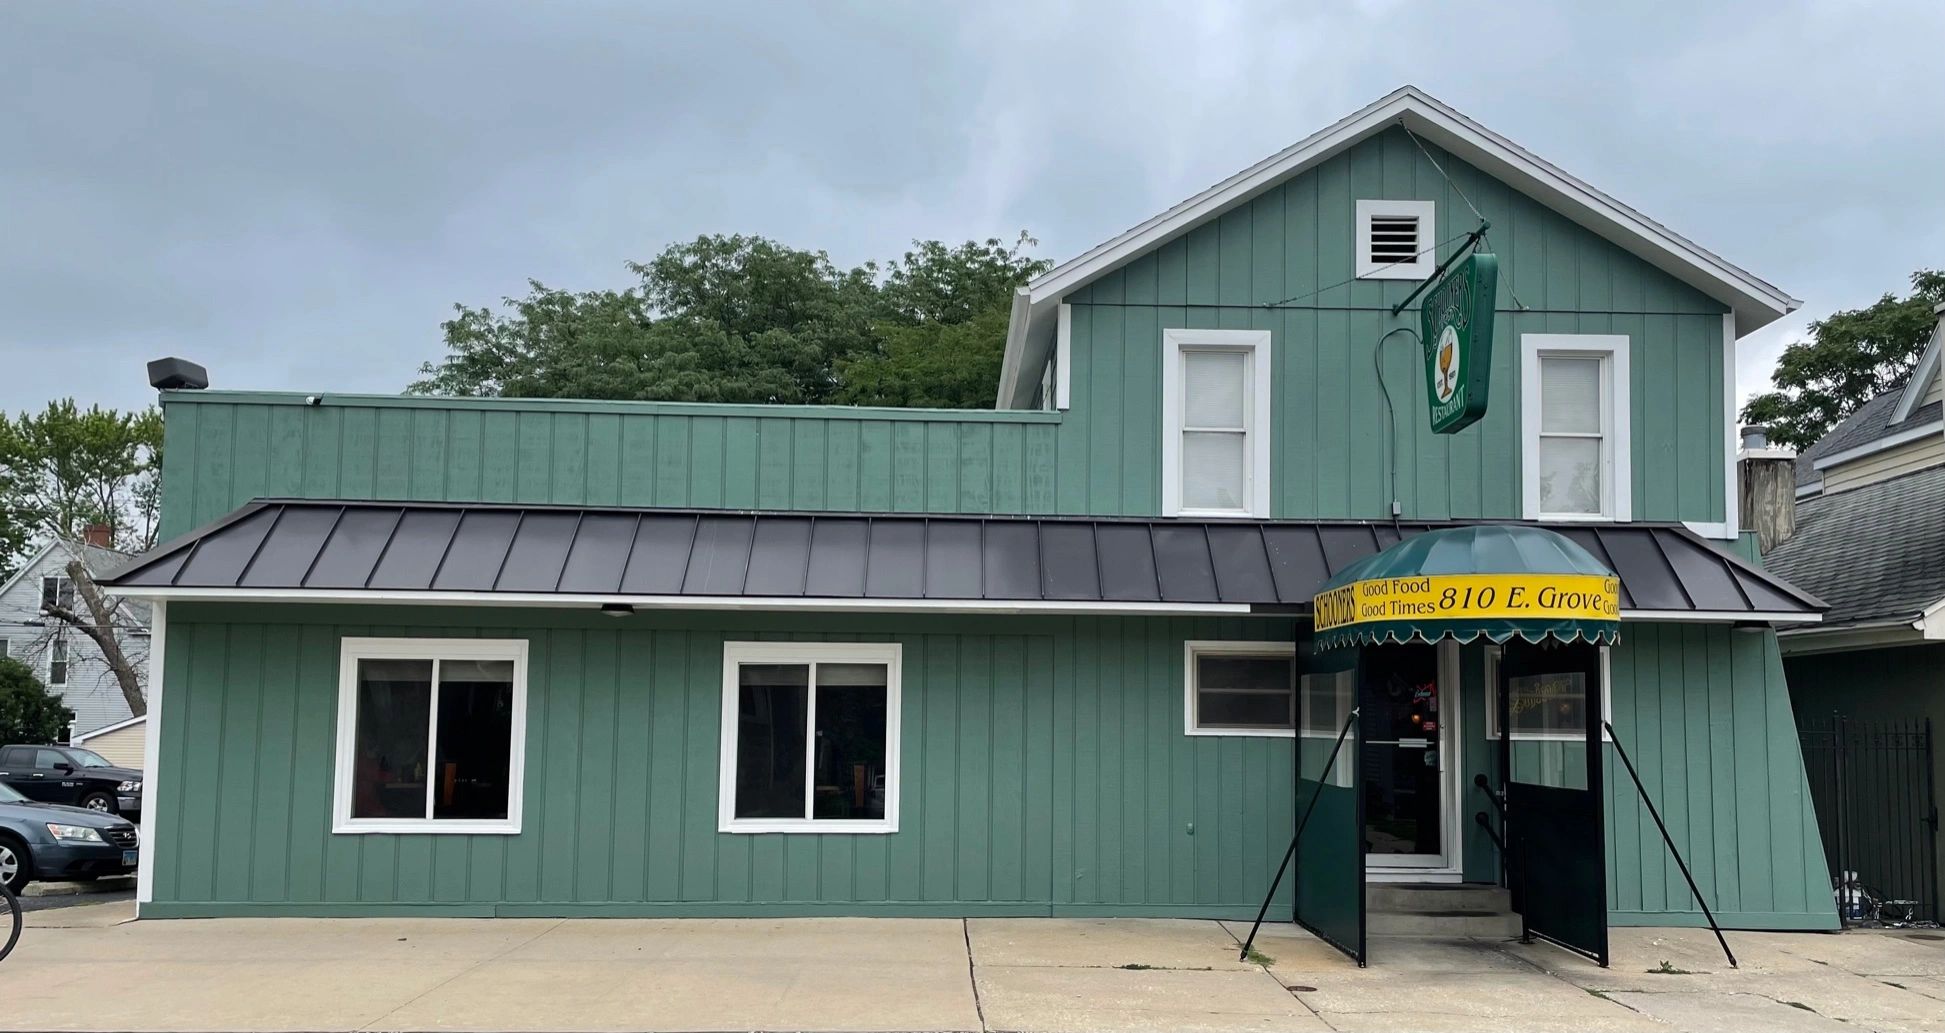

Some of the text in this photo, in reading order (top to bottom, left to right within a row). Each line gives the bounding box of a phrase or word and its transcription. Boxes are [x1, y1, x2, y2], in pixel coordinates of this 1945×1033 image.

[1432, 384, 1465, 426] RESTAURANT
[1362, 577, 1431, 597] Good Food
[1439, 586, 1602, 611] 810 E. Grove
[1315, 585, 1356, 630] SCHOONERS
[1361, 600, 1436, 617] Good Times
